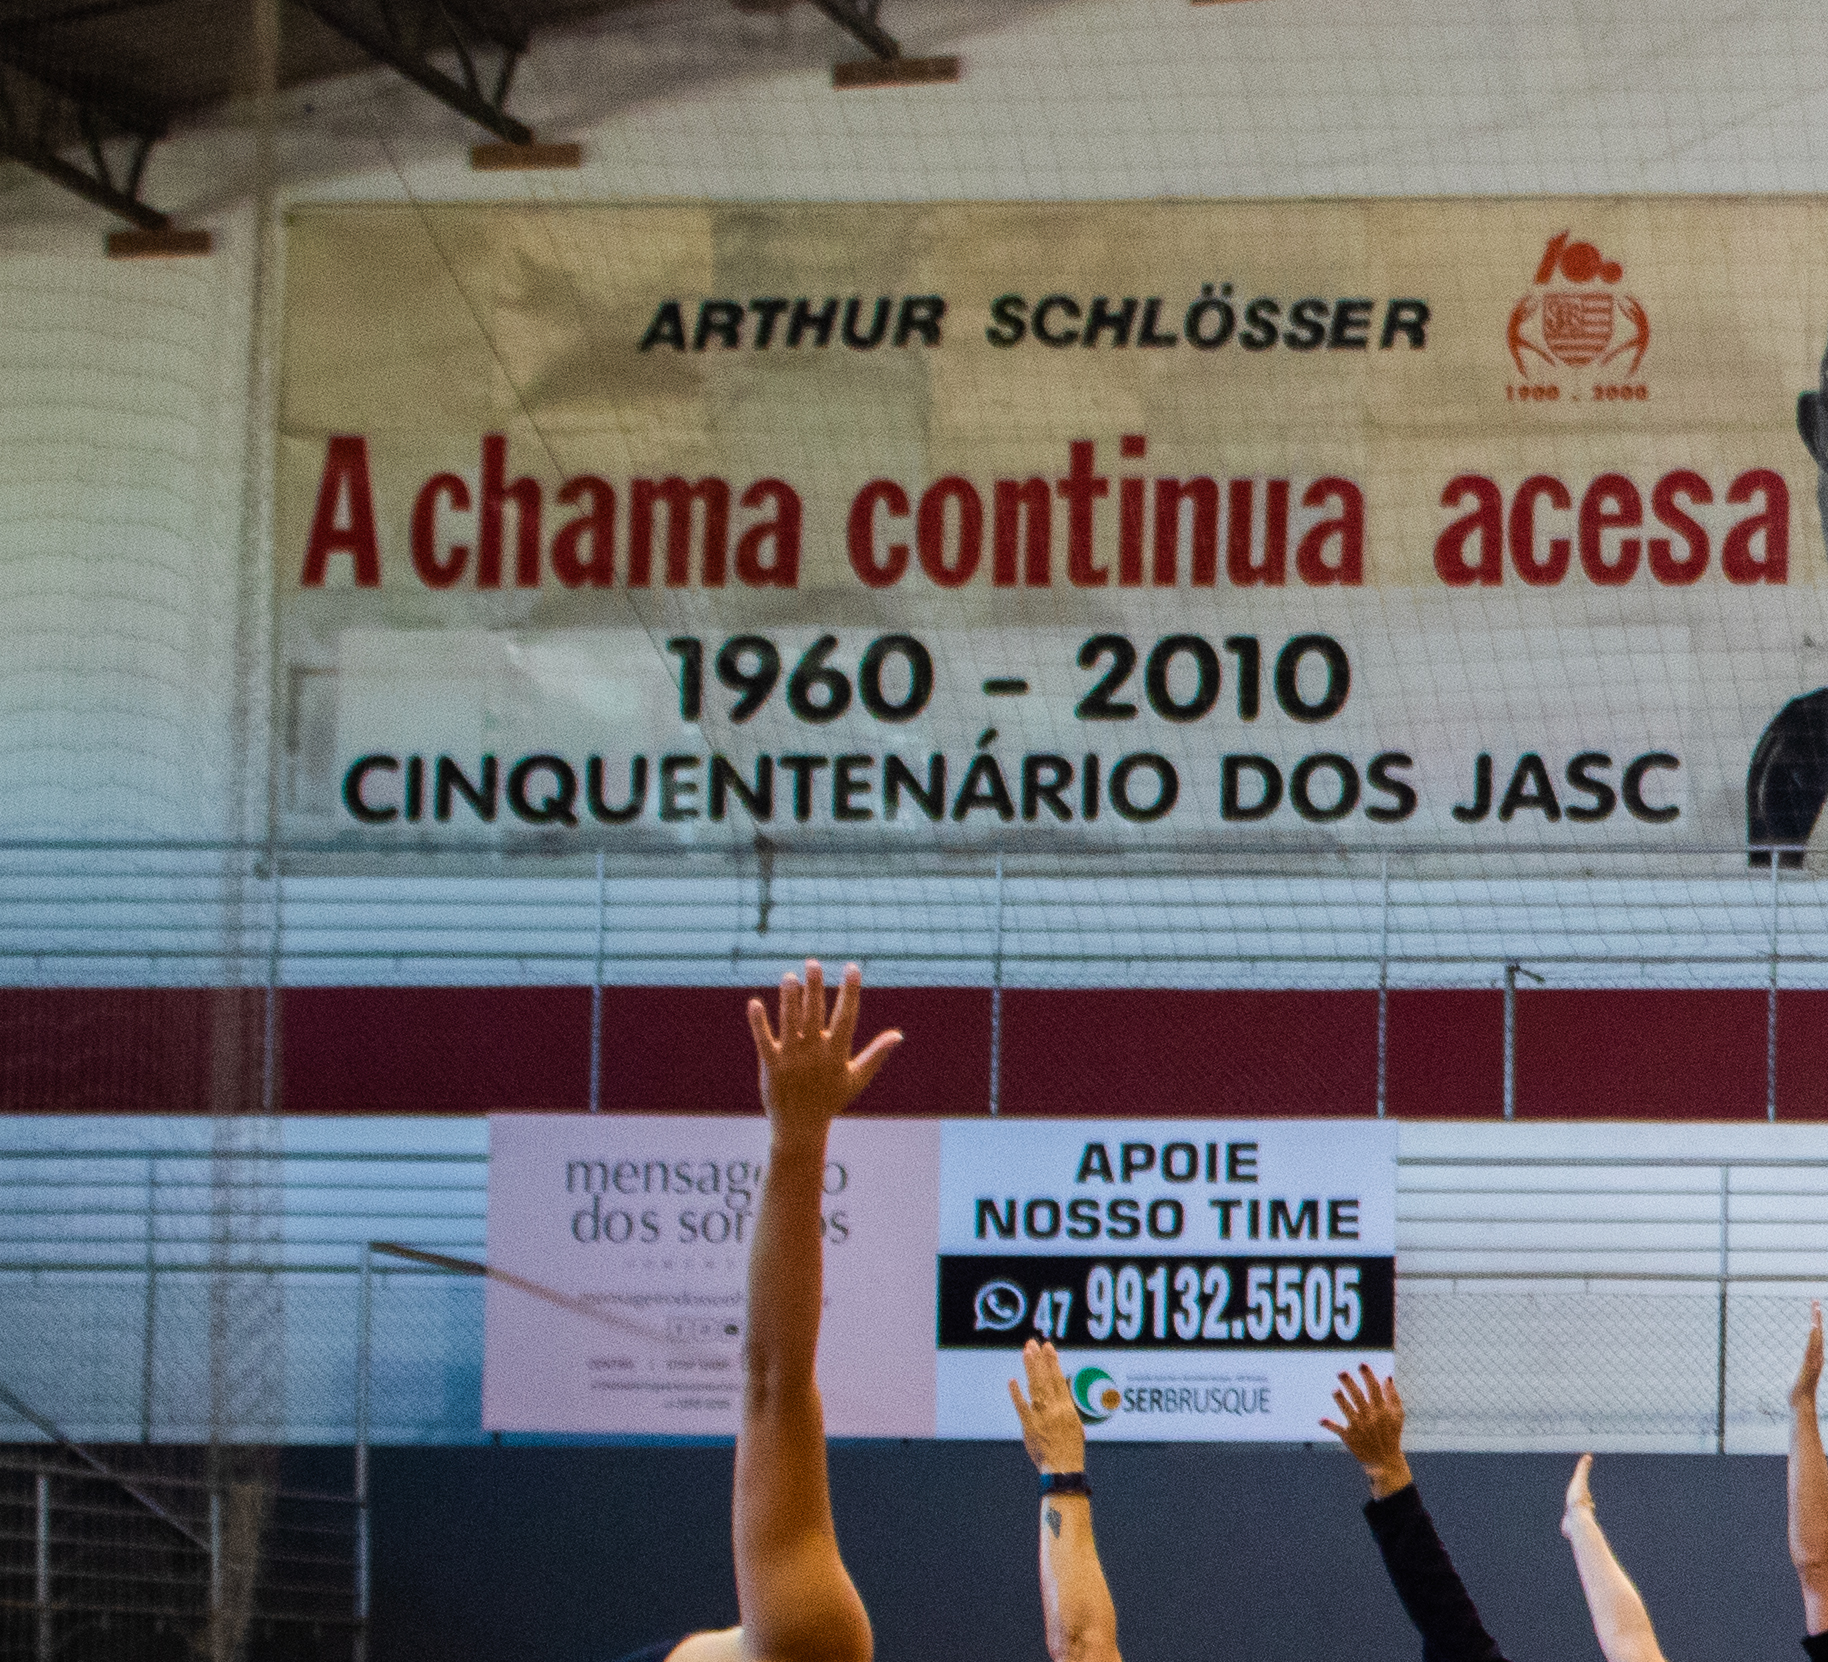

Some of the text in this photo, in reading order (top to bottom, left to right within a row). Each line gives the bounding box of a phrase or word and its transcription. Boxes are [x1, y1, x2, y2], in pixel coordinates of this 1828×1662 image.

[638, 285, 1430, 352] ARTHUR SCHLÖSSER
[302, 434, 1790, 588] A chama continua acesa
[667, 634, 934, 725] 1960
[1076, 633, 1351, 725] 2010
[341, 728, 1680, 828] CINQUENTENÁRIO DOS JASC
[566, 1159, 848, 1210] mensago
[1076, 1141, 1259, 1183] APOIE
[571, 1193, 661, 1244] dos
[975, 1198, 1360, 1240] NOSSO TIME
[1033, 1265, 1362, 1341] 47 99132.5505
[1123, 1387, 1270, 1416] SERBRUSQUE
